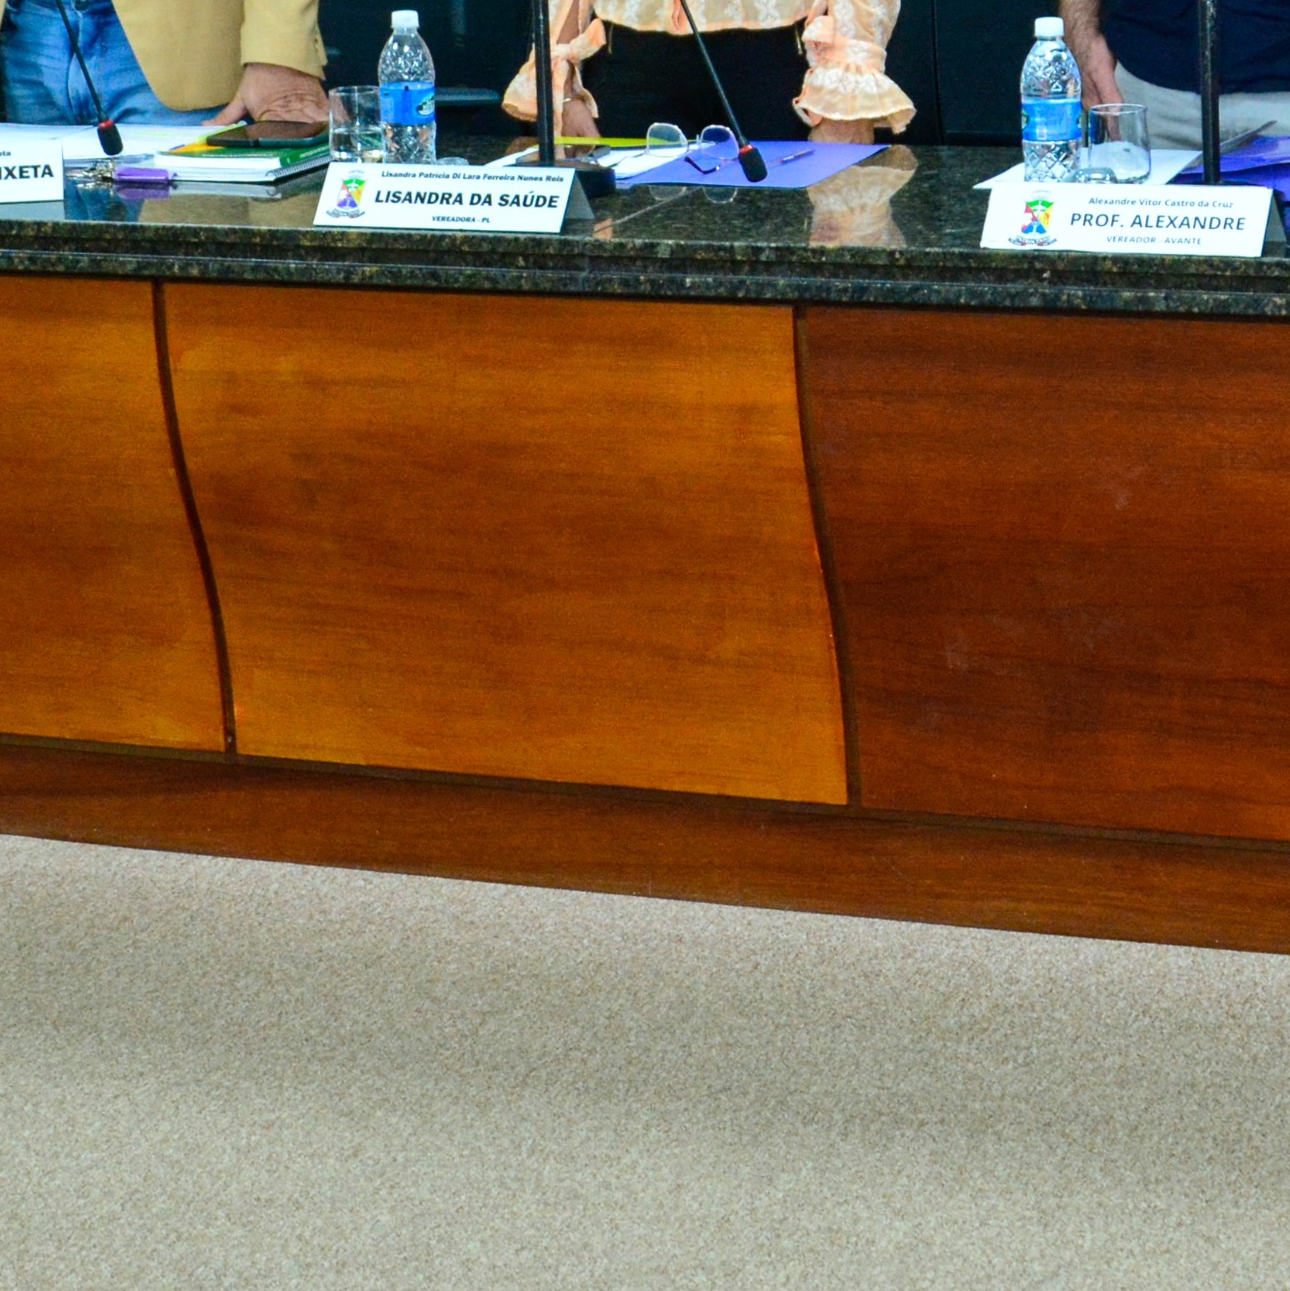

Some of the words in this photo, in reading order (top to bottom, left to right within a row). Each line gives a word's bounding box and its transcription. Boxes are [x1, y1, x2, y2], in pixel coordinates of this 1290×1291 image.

[381, 170, 417, 179] Lisandra
[463, 173, 481, 181] Lara
[482, 174, 516, 182] Ferreira
[375, 190, 463, 206] LISANDRA
[469, 193, 493, 206] DA
[498, 190, 559, 209] SAÚDE
[1088, 197, 1137, 207] Alexandre
[1139, 198, 1163, 207] Vitor
[1165, 199, 1196, 207] Castro
[1198, 198, 1210, 208] da
[1212, 200, 1234, 209] Cruz
[1070, 213, 1124, 228] PROF.
[1130, 214, 1247, 231] ALEXANDRE
[1107, 236, 1157, 244] VEREADOR
[1164, 238, 1202, 246] AVANTE
